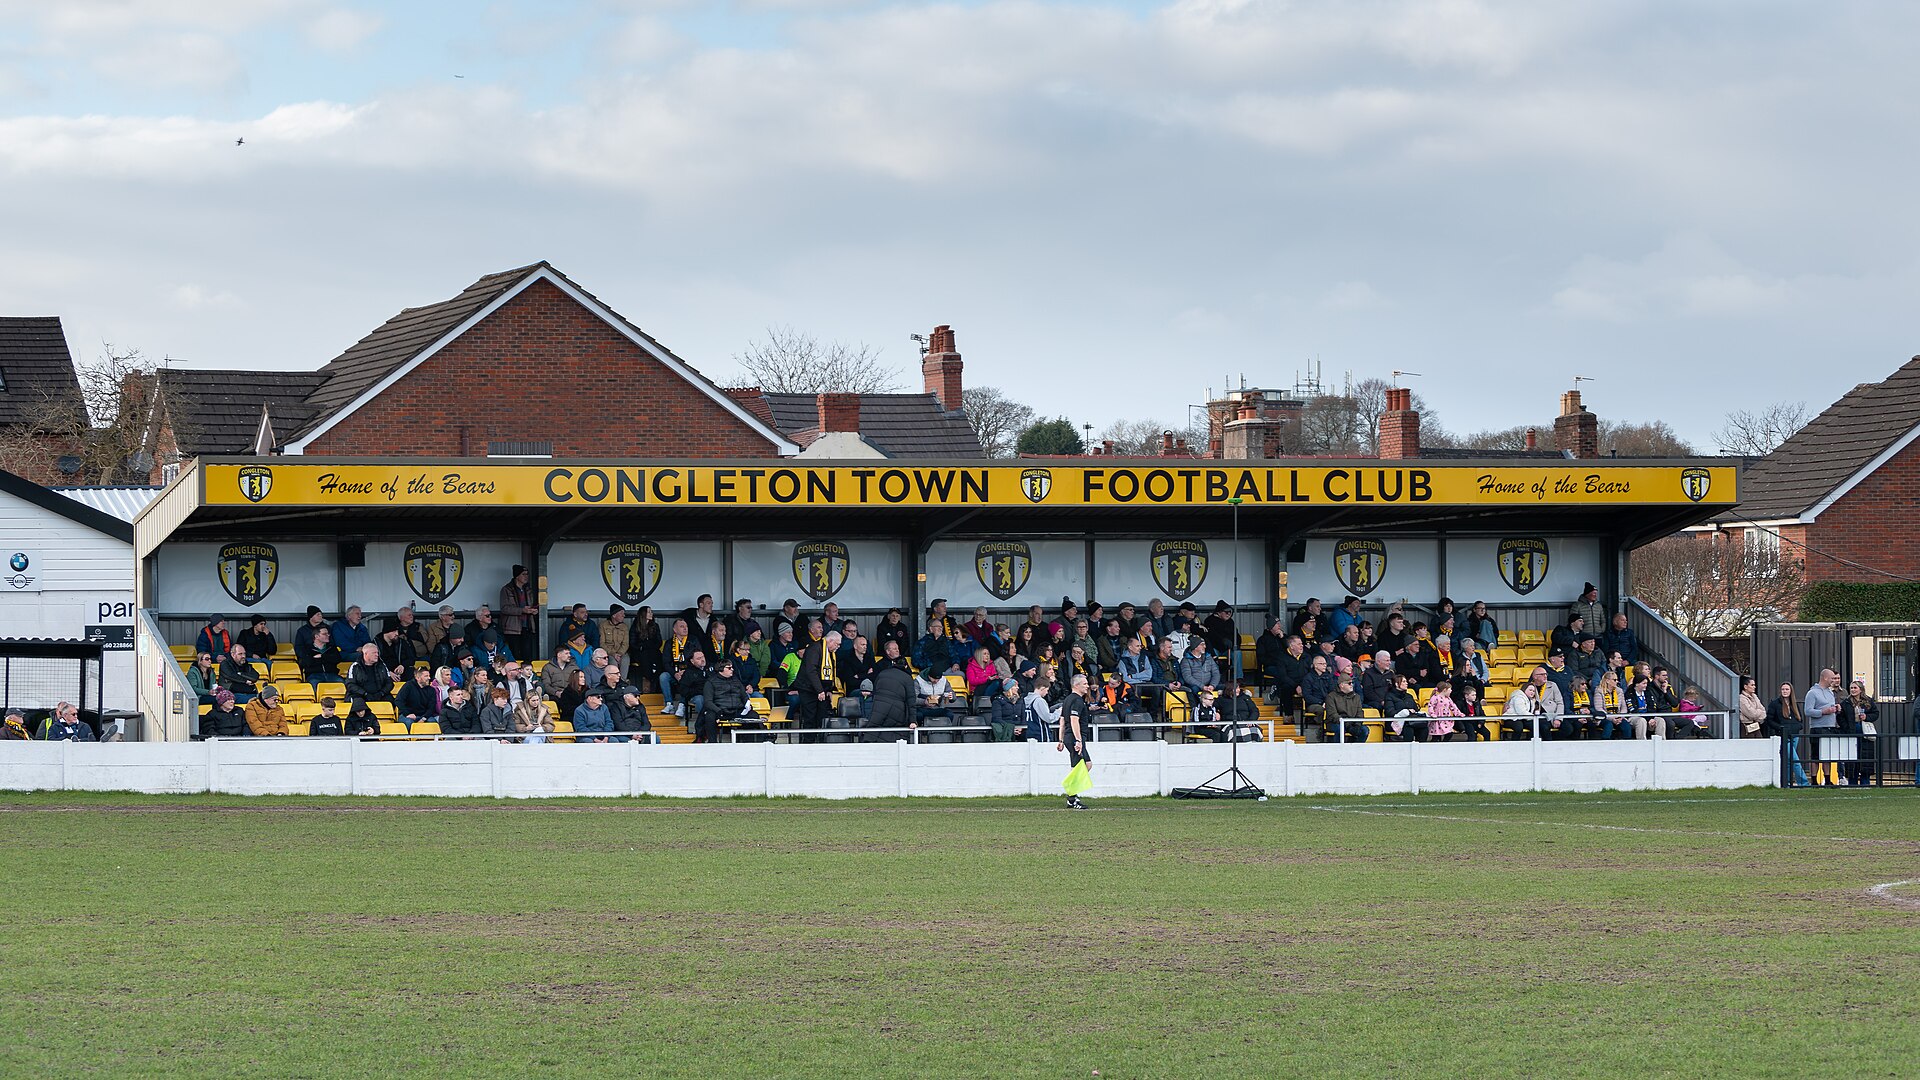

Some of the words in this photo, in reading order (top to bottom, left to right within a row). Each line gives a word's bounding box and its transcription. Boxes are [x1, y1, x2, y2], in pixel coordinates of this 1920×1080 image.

[317, 473, 373, 494] Home
[380, 475, 399, 501] of
[407, 473, 434, 495] the
[442, 473, 496, 495] Bears
[543, 469, 836, 503] CONGLETON
[851, 469, 989, 503] TOWN
[1083, 469, 1310, 503] FOOTBALL
[1323, 469, 1433, 503] CLUB
[1476, 474, 1525, 494] Home
[1531, 476, 1548, 500] of
[1554, 474, 1578, 494] the
[1584, 474, 1631, 494] Bears
[607, 544, 656, 555] CONGLETON
[798, 543, 845, 555] CONGLETON
[980, 542, 1026, 553] CONGLETON
[1156, 541, 1202, 552] CONGLETON
[1338, 540, 1382, 551] CONGLETON
[1502, 539, 1545, 550] CONGLETON
[223, 546, 273, 557] CONGLETON
[410, 545, 458, 556] CONGLETON
